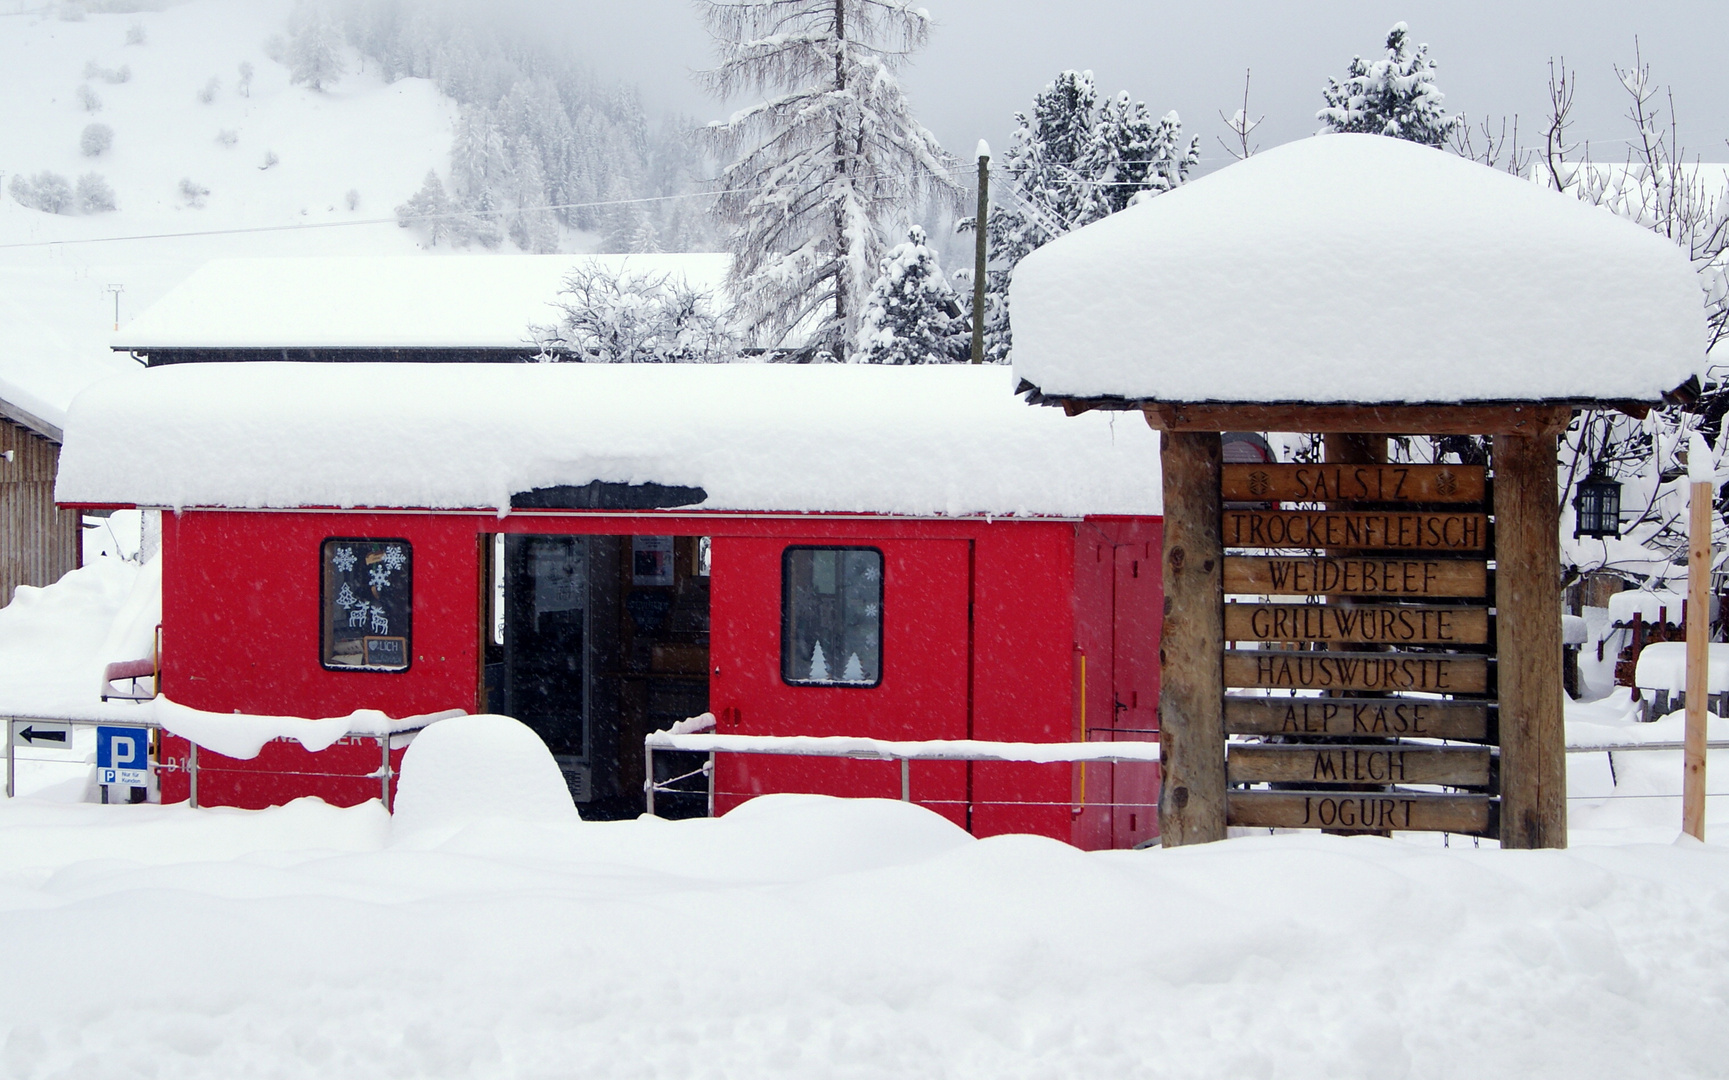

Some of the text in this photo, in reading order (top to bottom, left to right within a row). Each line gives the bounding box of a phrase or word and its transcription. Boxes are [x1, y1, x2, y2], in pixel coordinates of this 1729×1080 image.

[1295, 467, 1410, 500] SALSIZ
[1232, 514, 1479, 549] TROCKENFLEISCH
[1269, 560, 1438, 593] WEIDEBEEF
[1251, 608, 1454, 641] GRILLWÜRSTE
[1257, 657, 1451, 689] HAUSWÜRSTE
[1282, 704, 1428, 734] ALP KÄSE
[111, 736, 135, 769] P
[168, 756, 176, 773] D
[1313, 750, 1406, 781] MILCH
[107, 772, 115, 782] P
[1302, 797, 1417, 827] JOGURT
